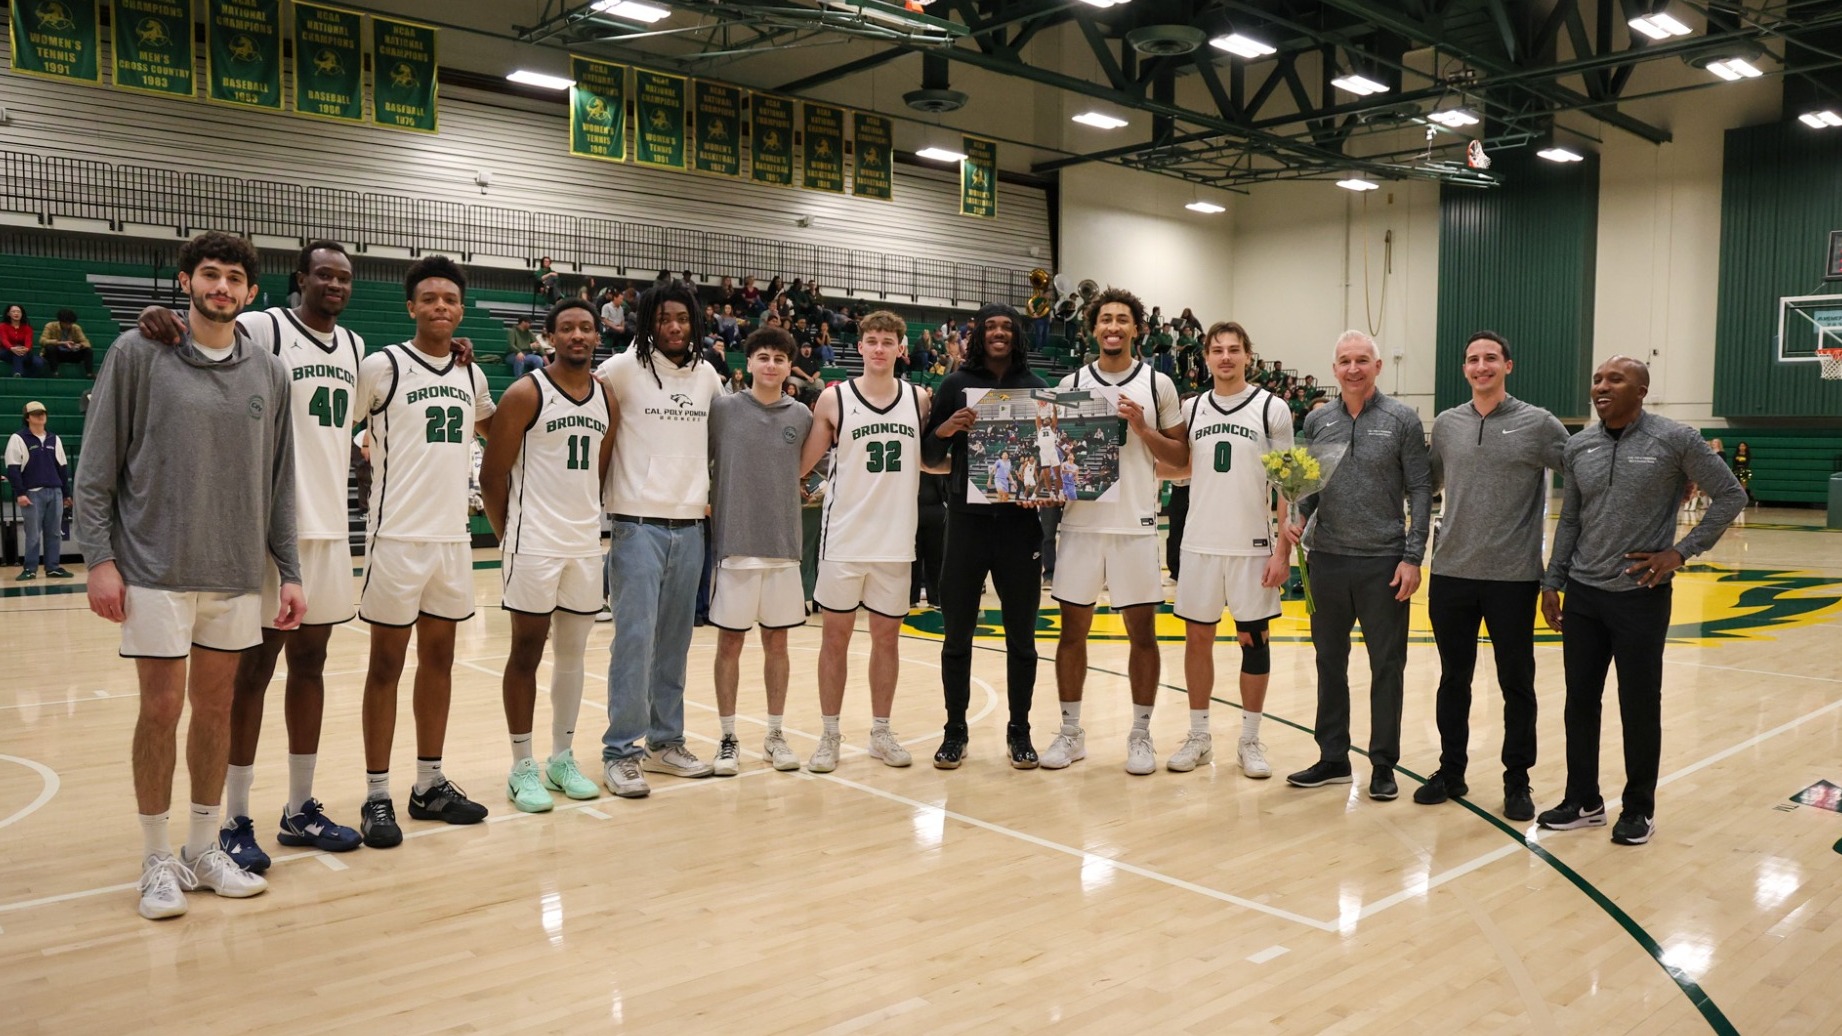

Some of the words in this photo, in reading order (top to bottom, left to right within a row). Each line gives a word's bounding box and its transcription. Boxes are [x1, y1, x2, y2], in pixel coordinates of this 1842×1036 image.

[122, 0, 184, 17] CHAMPIONS
[221, 3, 266, 21] NATIONAL
[316, 10, 340, 22] NCAA
[216, 16, 273, 35] CHAMPIONS
[306, 20, 349, 36] NATIONAL
[393, 25, 416, 36] NCAA
[30, 32, 82, 50] WOMEN'S
[301, 31, 355, 49] CHAMPIONS
[384, 34, 424, 50] NATIONAL
[36, 47, 76, 63] TENNIS
[139, 51, 170, 64] MEN'S
[379, 45, 429, 62] CHAMPIONS
[43, 62, 70, 74] 1991
[118, 59, 148, 72] CROSS
[151, 65, 190, 79] COUNTRY
[222, 76, 269, 93] BASEBALL
[307, 90, 351, 105] BASEBALL
[384, 101, 425, 116] BASEBALL
[582, 122, 615, 135] WOMEN'S
[586, 133, 611, 145] TENNIS
[645, 132, 676, 145] WOMEN'S
[649, 143, 673, 154] TENNIS
[292, 364, 355, 388] BRONCOS
[406, 385, 472, 407] BRONCOS
[309, 386, 349, 428] 40
[664, 408, 683, 416] POLY
[425, 406, 463, 443] 22
[546, 415, 607, 437] BRONCOS
[851, 422, 915, 441] BRONCOS
[1195, 423, 1259, 442] BRONCOS
[567, 434, 590, 470] 11
[866, 440, 901, 473] 32
[1213, 441, 1232, 473] 0
